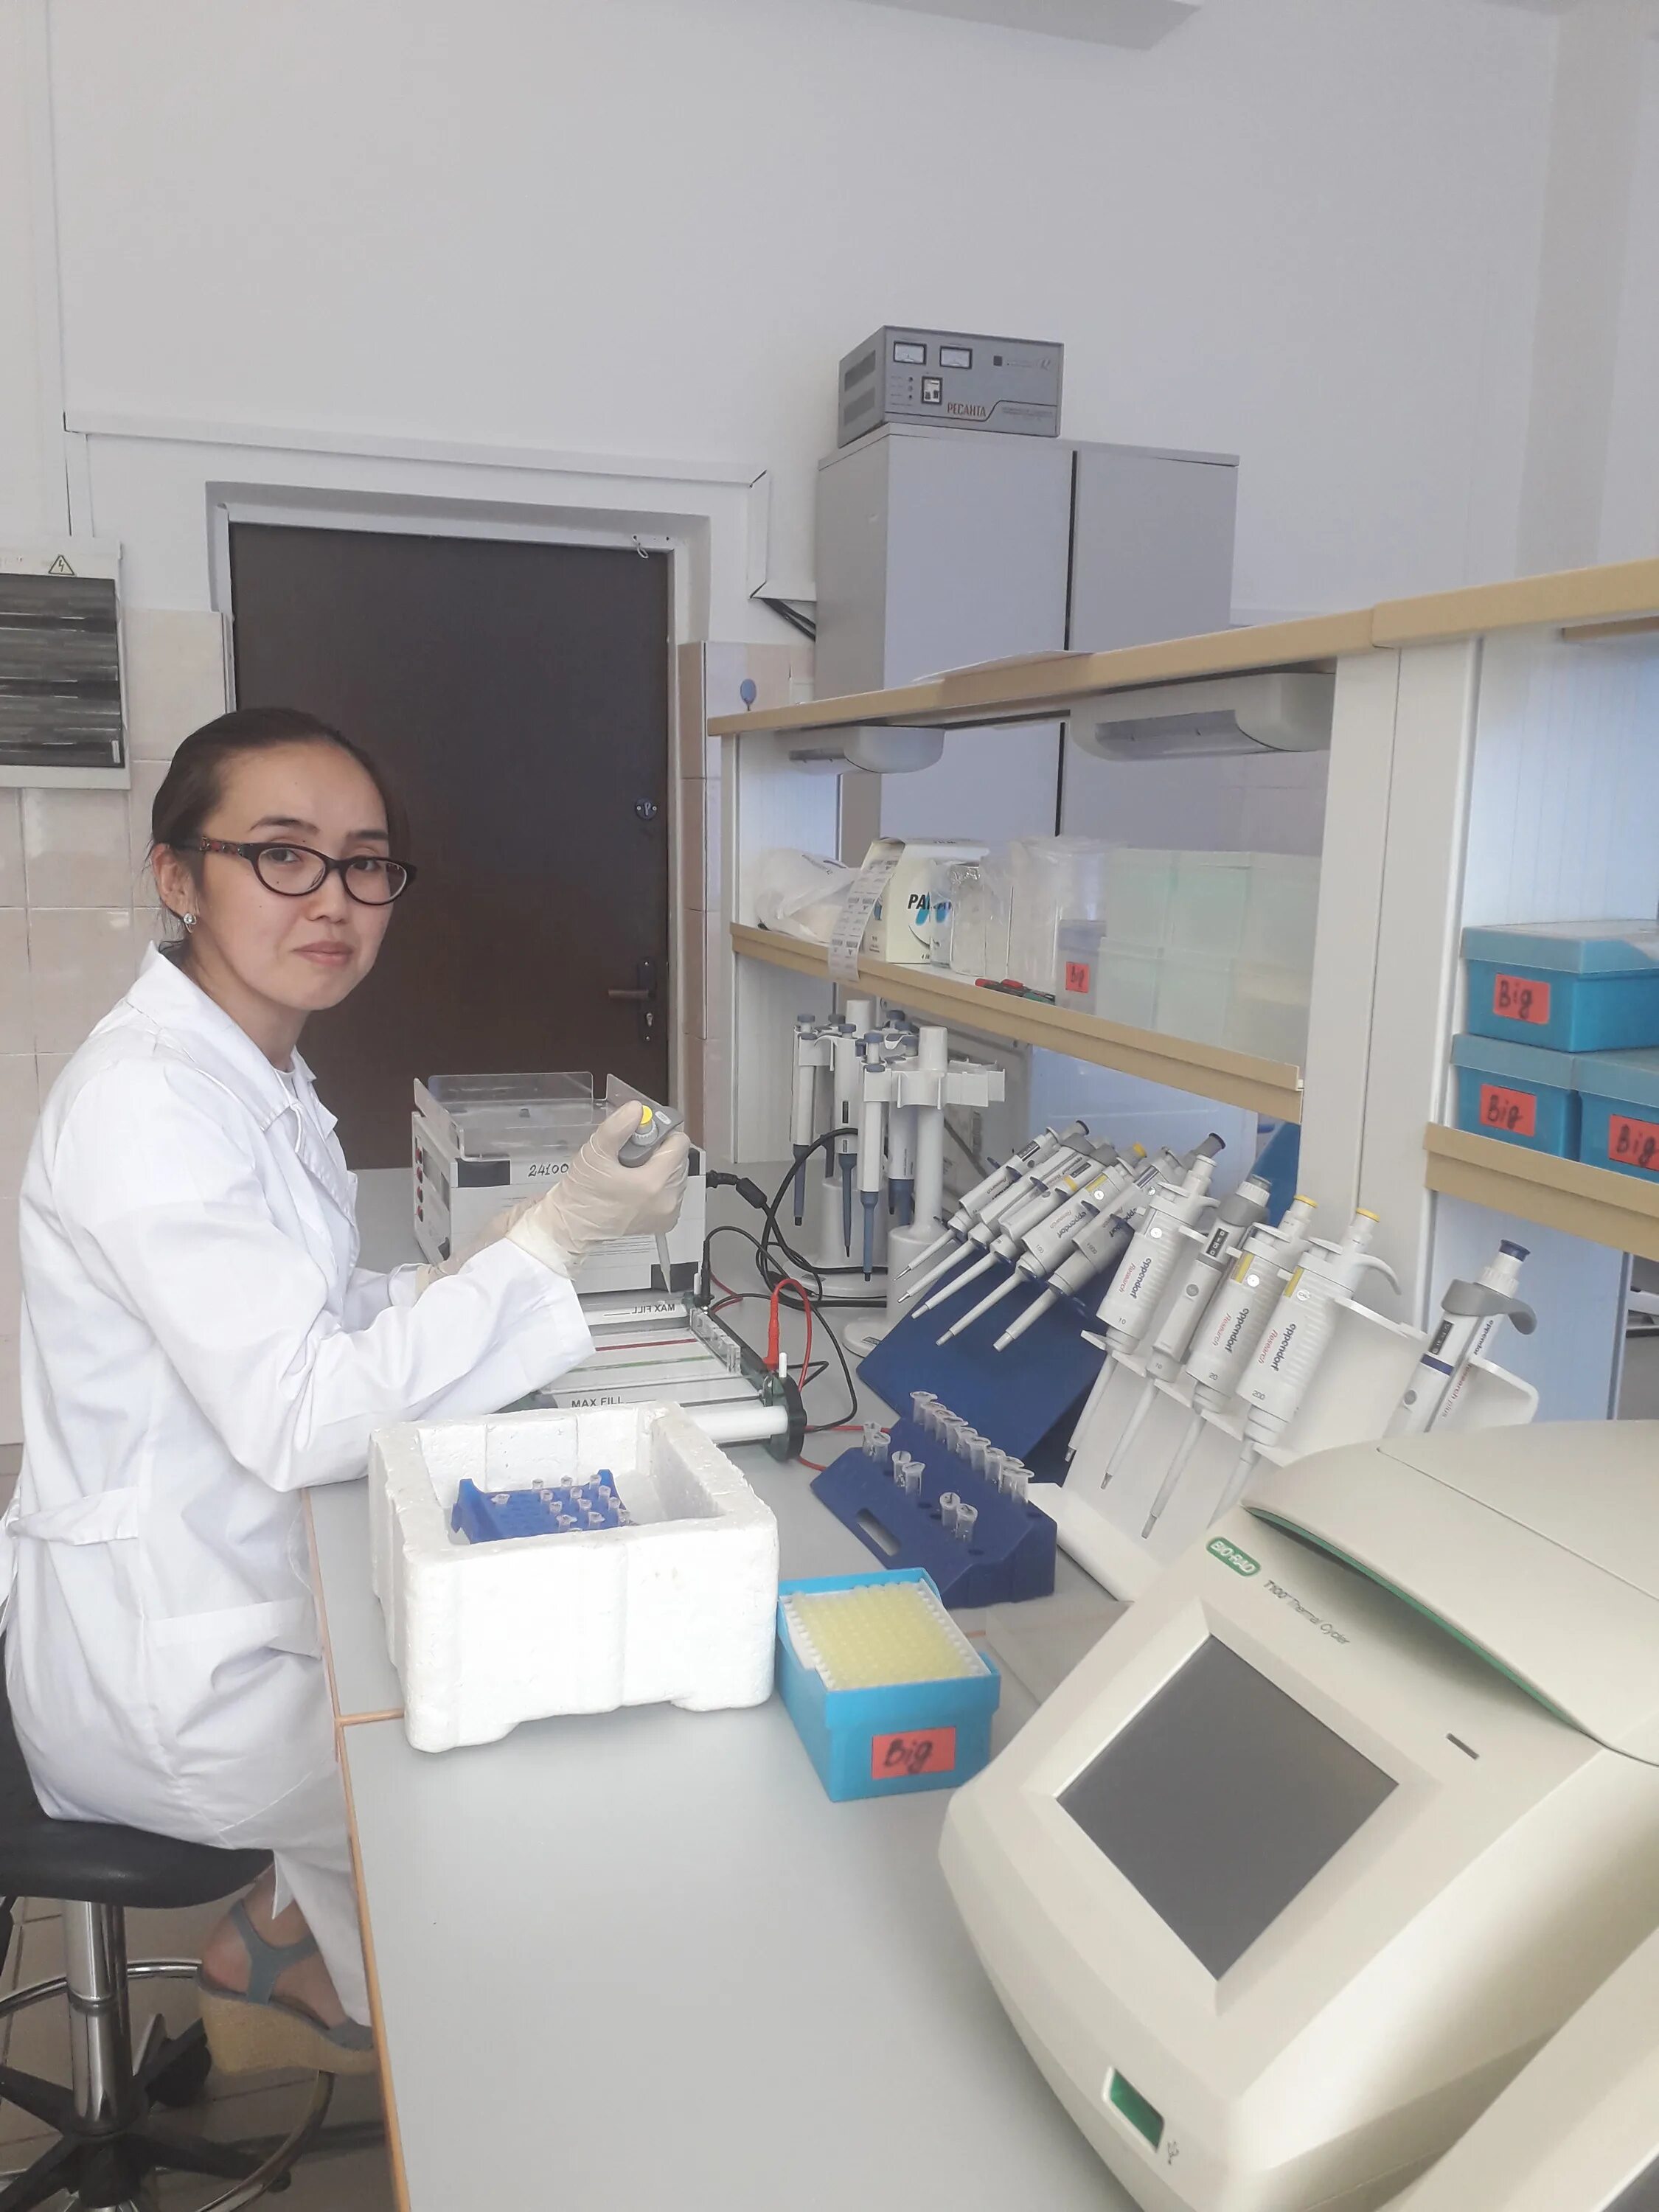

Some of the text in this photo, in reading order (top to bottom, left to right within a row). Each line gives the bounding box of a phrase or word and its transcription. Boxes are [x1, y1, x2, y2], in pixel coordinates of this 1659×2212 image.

[947, 403, 986, 417] РЕСАНТА
[1499, 979, 1533, 1020] Big
[1486, 1094, 1523, 1130] Big
[1616, 1123, 1659, 1168] Big
[528, 1163, 568, 1177] 24100
[1057, 1211, 1087, 1238] eppendorf
[1119, 1263, 1136, 1293] Research
[1130, 1257, 1152, 1298] eppendorf
[1119, 1317, 1127, 1325] 10
[1212, 1312, 1232, 1346] Research
[1225, 1307, 1250, 1354] eppendorf
[1258, 1329, 1279, 1364] Research
[1270, 1323, 1296, 1371] eppendorf
[1209, 1372, 1218, 1381] 20
[571, 1396, 624, 1408] MAX FILL
[1252, 1390, 1265, 1400] 200
[1210, 1540, 1256, 1573] BIO-RAD
[1320, 1623, 1350, 1644] Cycler
[884, 1738, 933, 1774] Big
